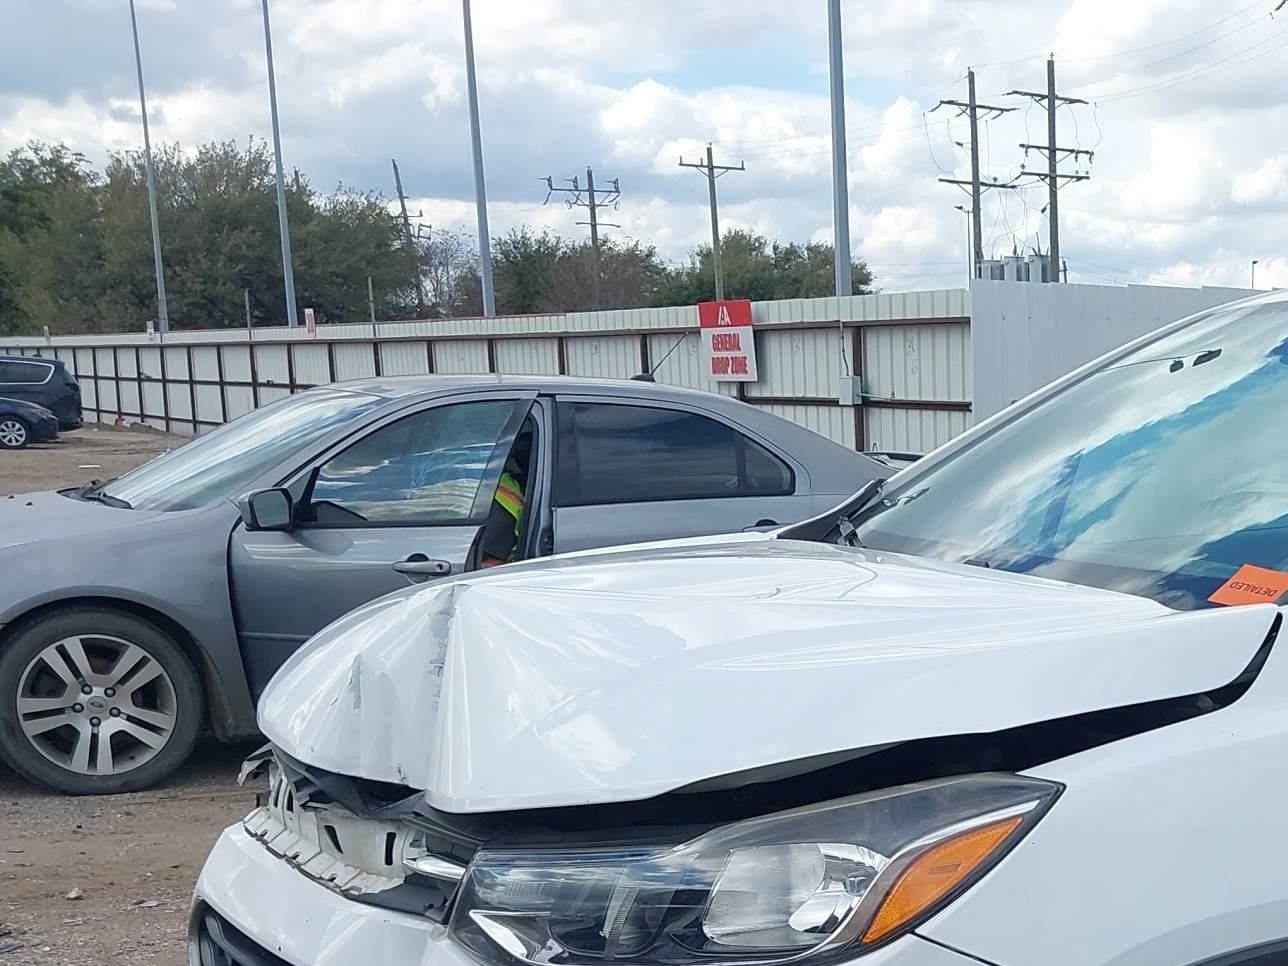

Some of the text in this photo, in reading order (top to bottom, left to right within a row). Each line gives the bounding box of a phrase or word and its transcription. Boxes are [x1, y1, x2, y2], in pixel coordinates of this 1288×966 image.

[712, 333, 741, 352] GENERAL
[711, 356, 748, 375] DROP ZONE
[1229, 581, 1278, 597] DETAILED
